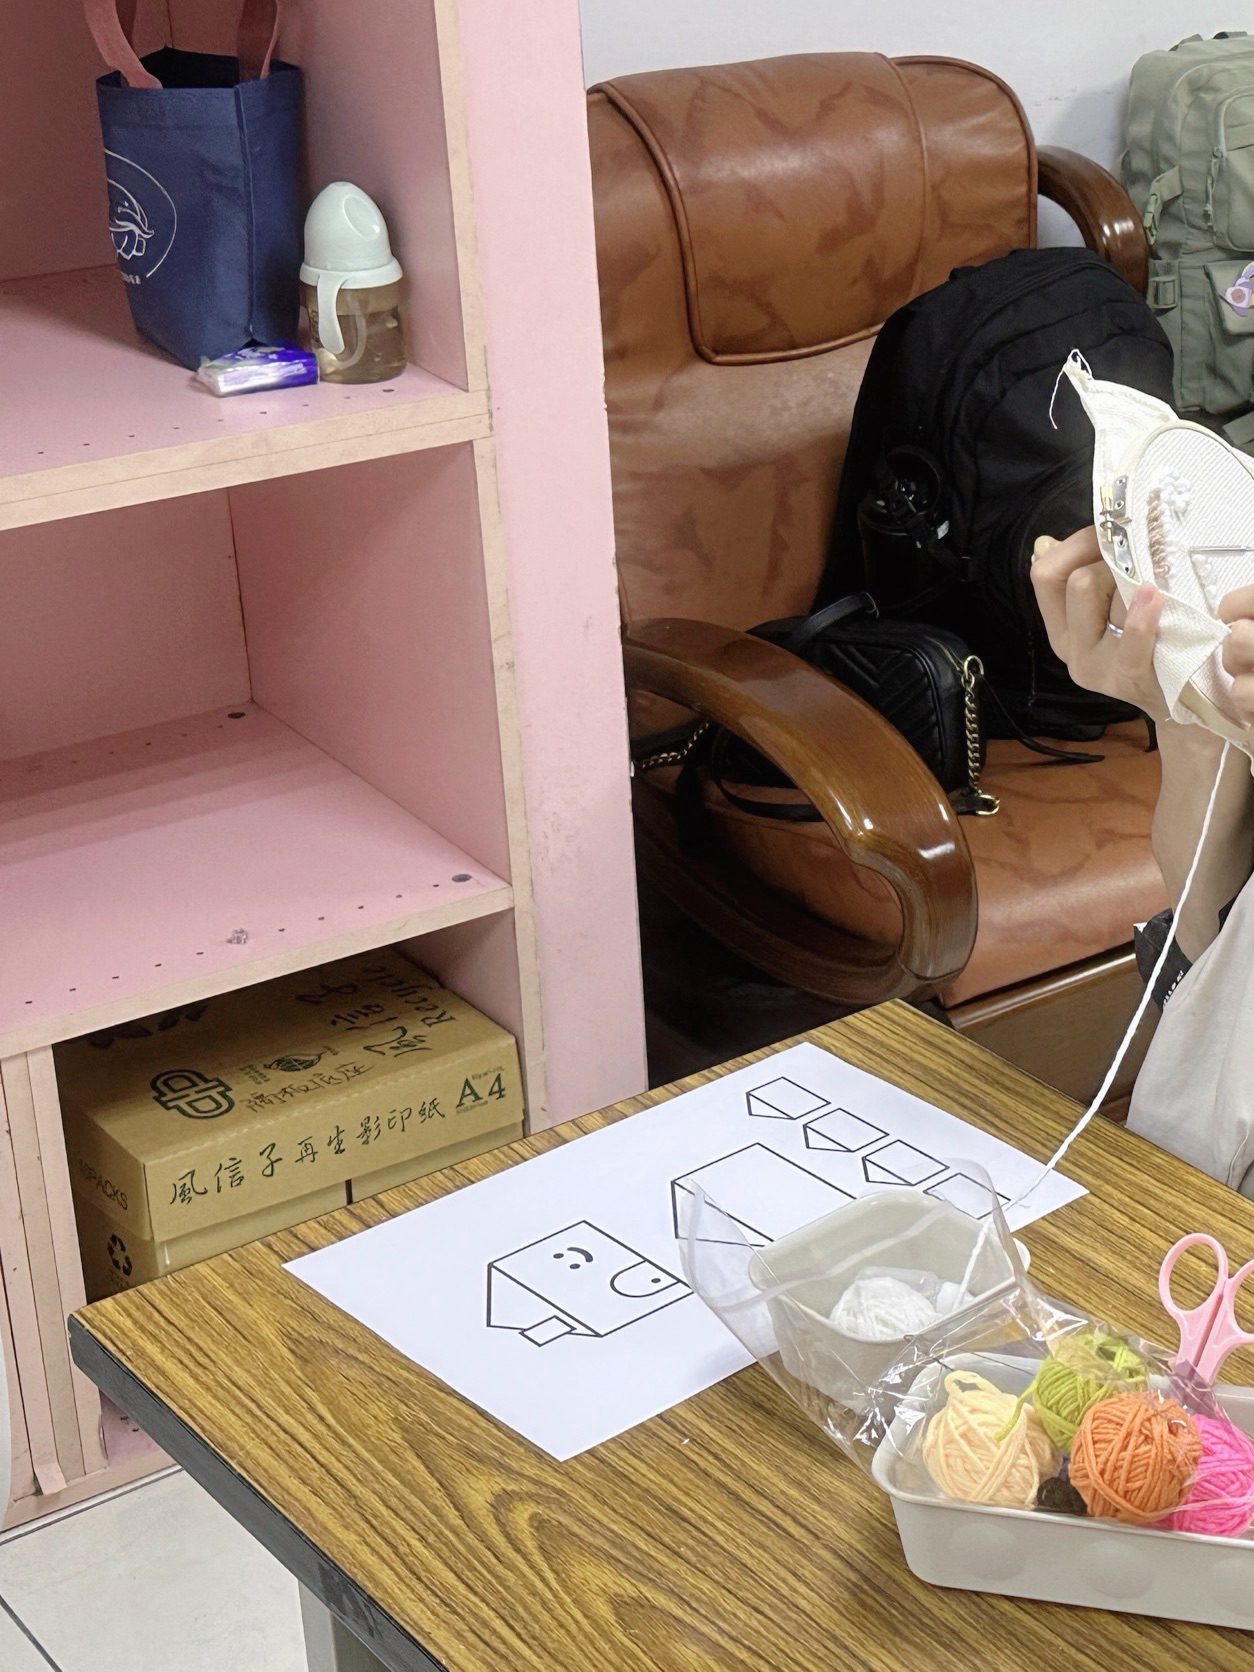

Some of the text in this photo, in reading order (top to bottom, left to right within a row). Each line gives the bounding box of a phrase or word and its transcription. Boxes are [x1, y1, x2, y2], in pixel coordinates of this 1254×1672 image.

[356, 965, 457, 1028] Recycle
[456, 1072, 506, 1109] A4
[169, 1097, 446, 1206] 風信子再生影印紙
